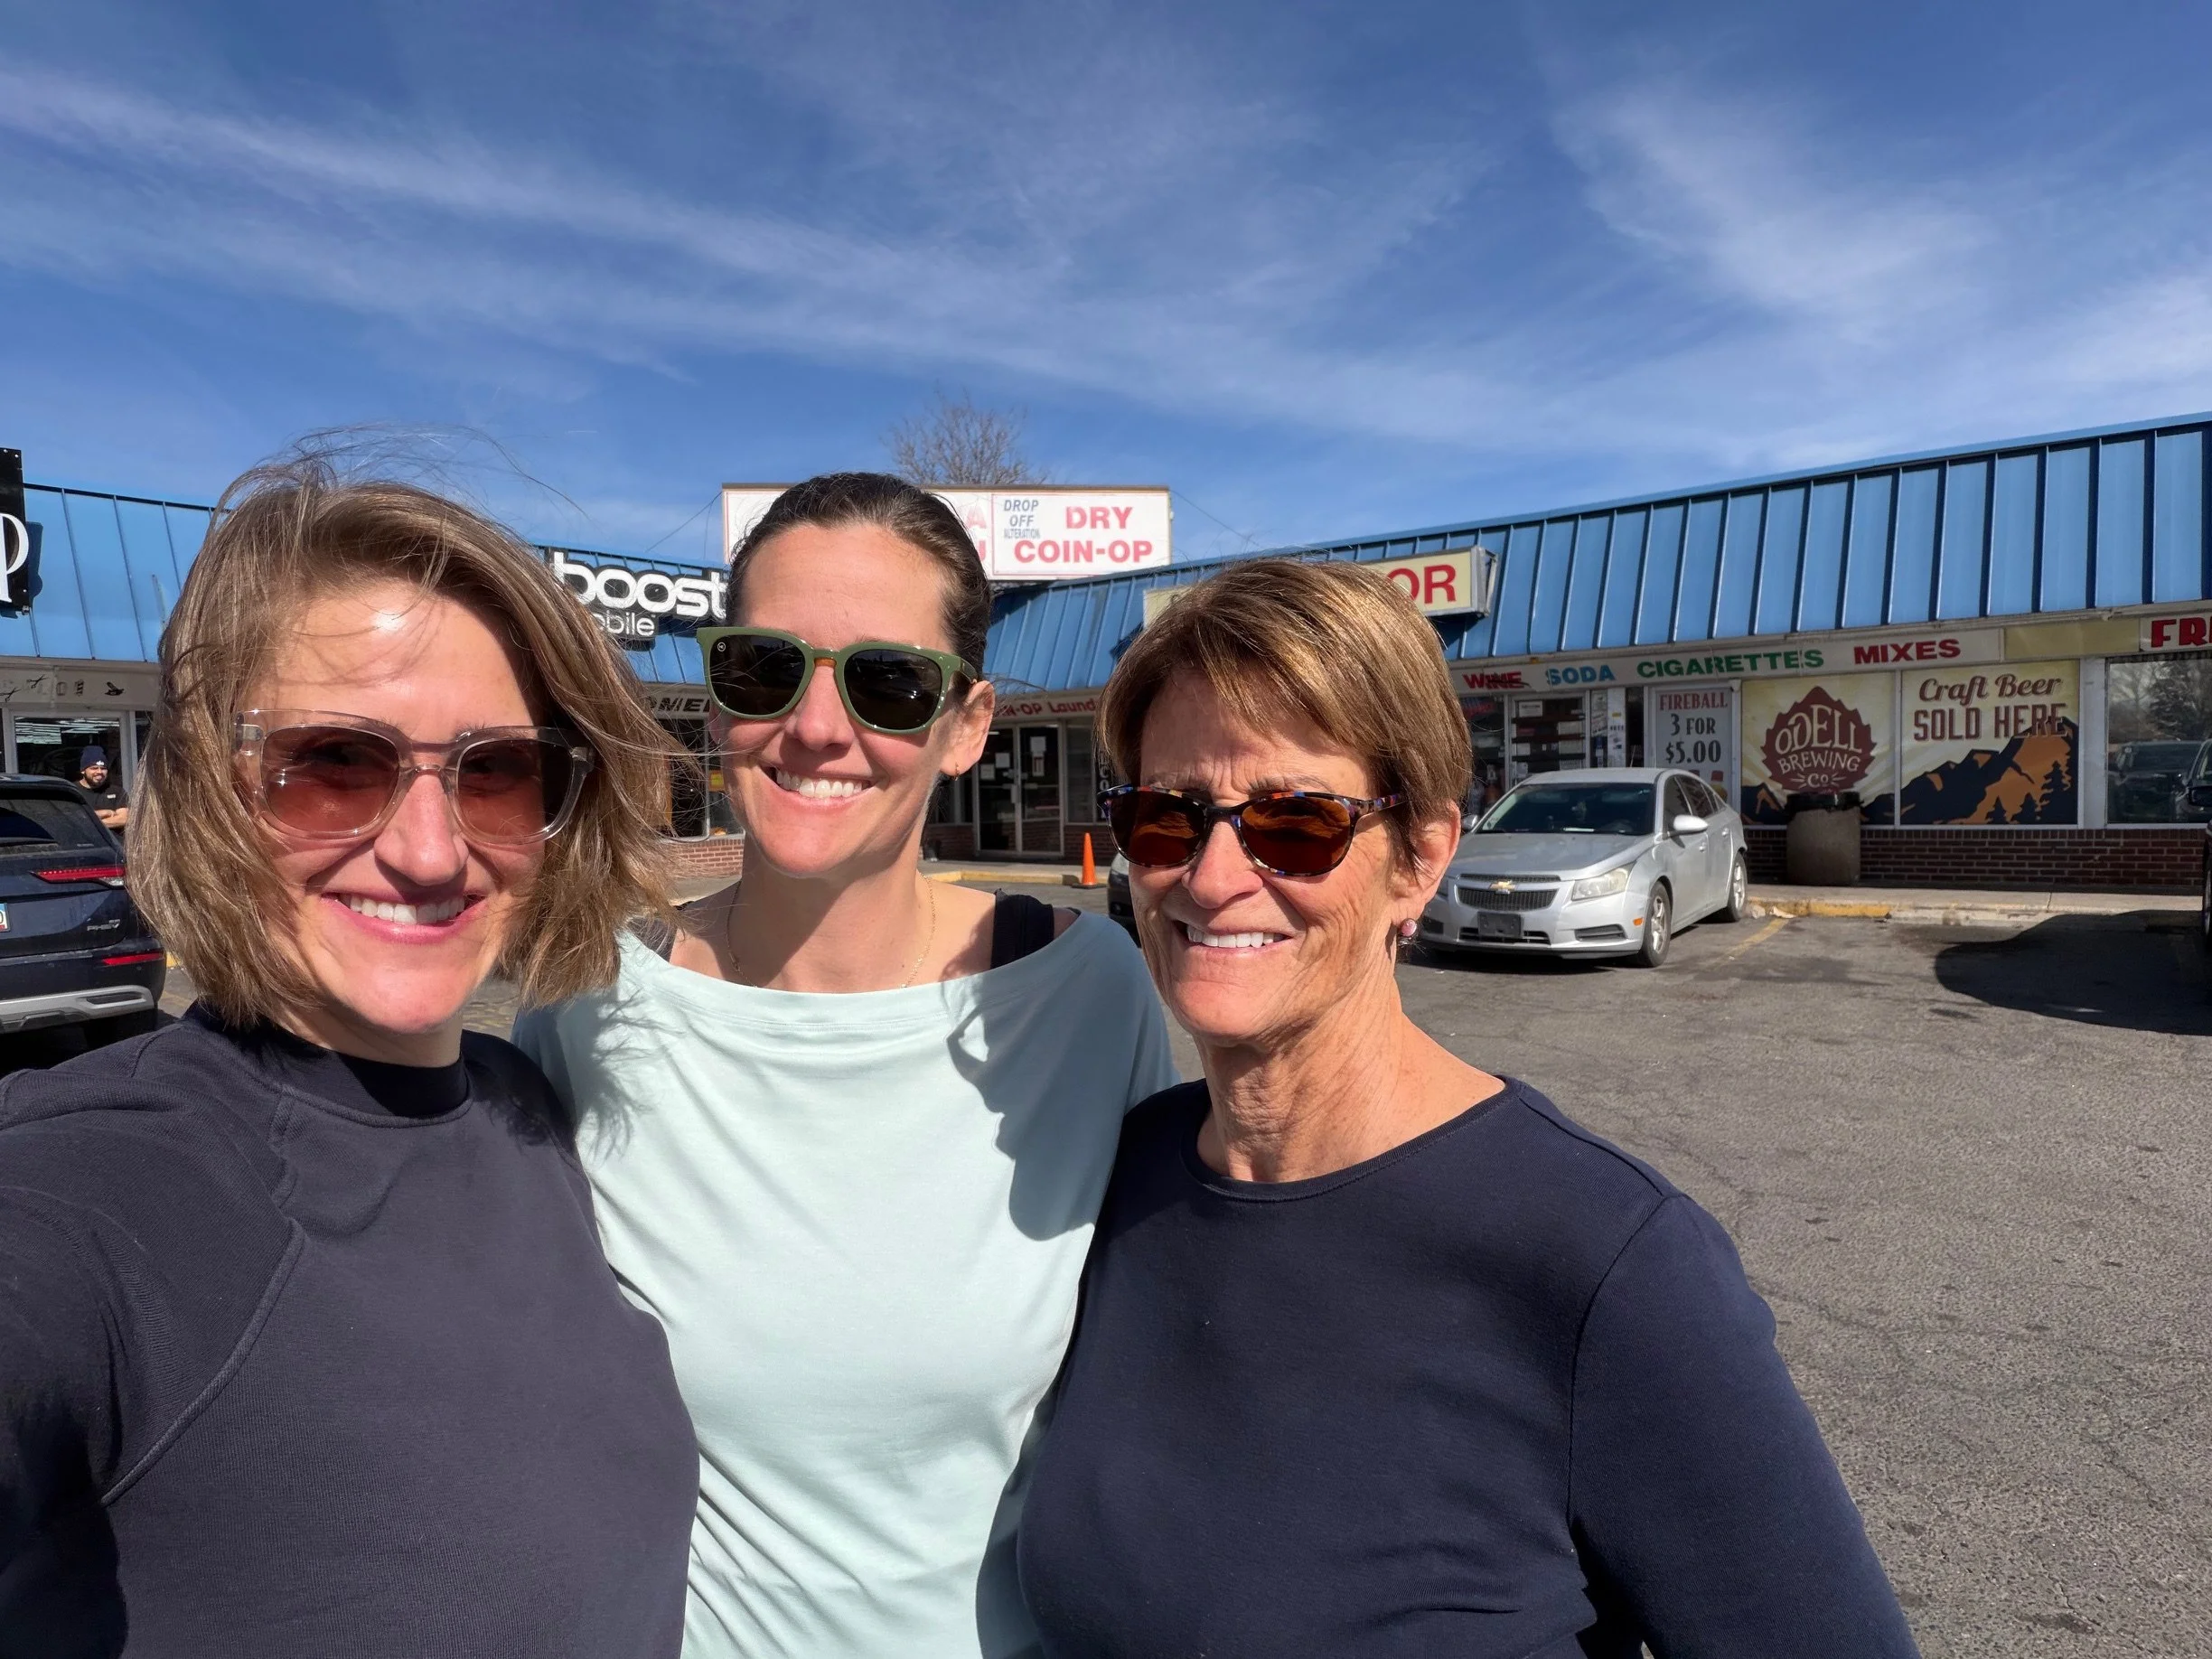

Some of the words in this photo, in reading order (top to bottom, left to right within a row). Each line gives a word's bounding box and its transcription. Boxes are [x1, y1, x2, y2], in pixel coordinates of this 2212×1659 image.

[1004, 500, 1039, 511] DROP
[1066, 506, 1133, 529] DRY
[1009, 514, 1034, 527] OFF
[1014, 540, 1153, 563] COIN-OP
[553, 551, 728, 620] boost
[2151, 616, 2212, 648] FR
[1545, 664, 1617, 686] SODA
[1636, 649, 1824, 679] CIGARETTES
[1853, 638, 1962, 664] MIXES
[1659, 692, 1728, 711] FIREBALL
[1918, 675, 1988, 706] Craft
[1994, 673, 2065, 698] Beer
[1670, 713, 1681, 736] 3
[1686, 717, 1716, 735] FOR
[1775, 704, 1862, 755] ODELL
[1913, 707, 1982, 741] SOLD
[1993, 702, 2068, 739] HERE
[1665, 739, 1721, 764] $5.00
[1777, 750, 1861, 773] BREWING
